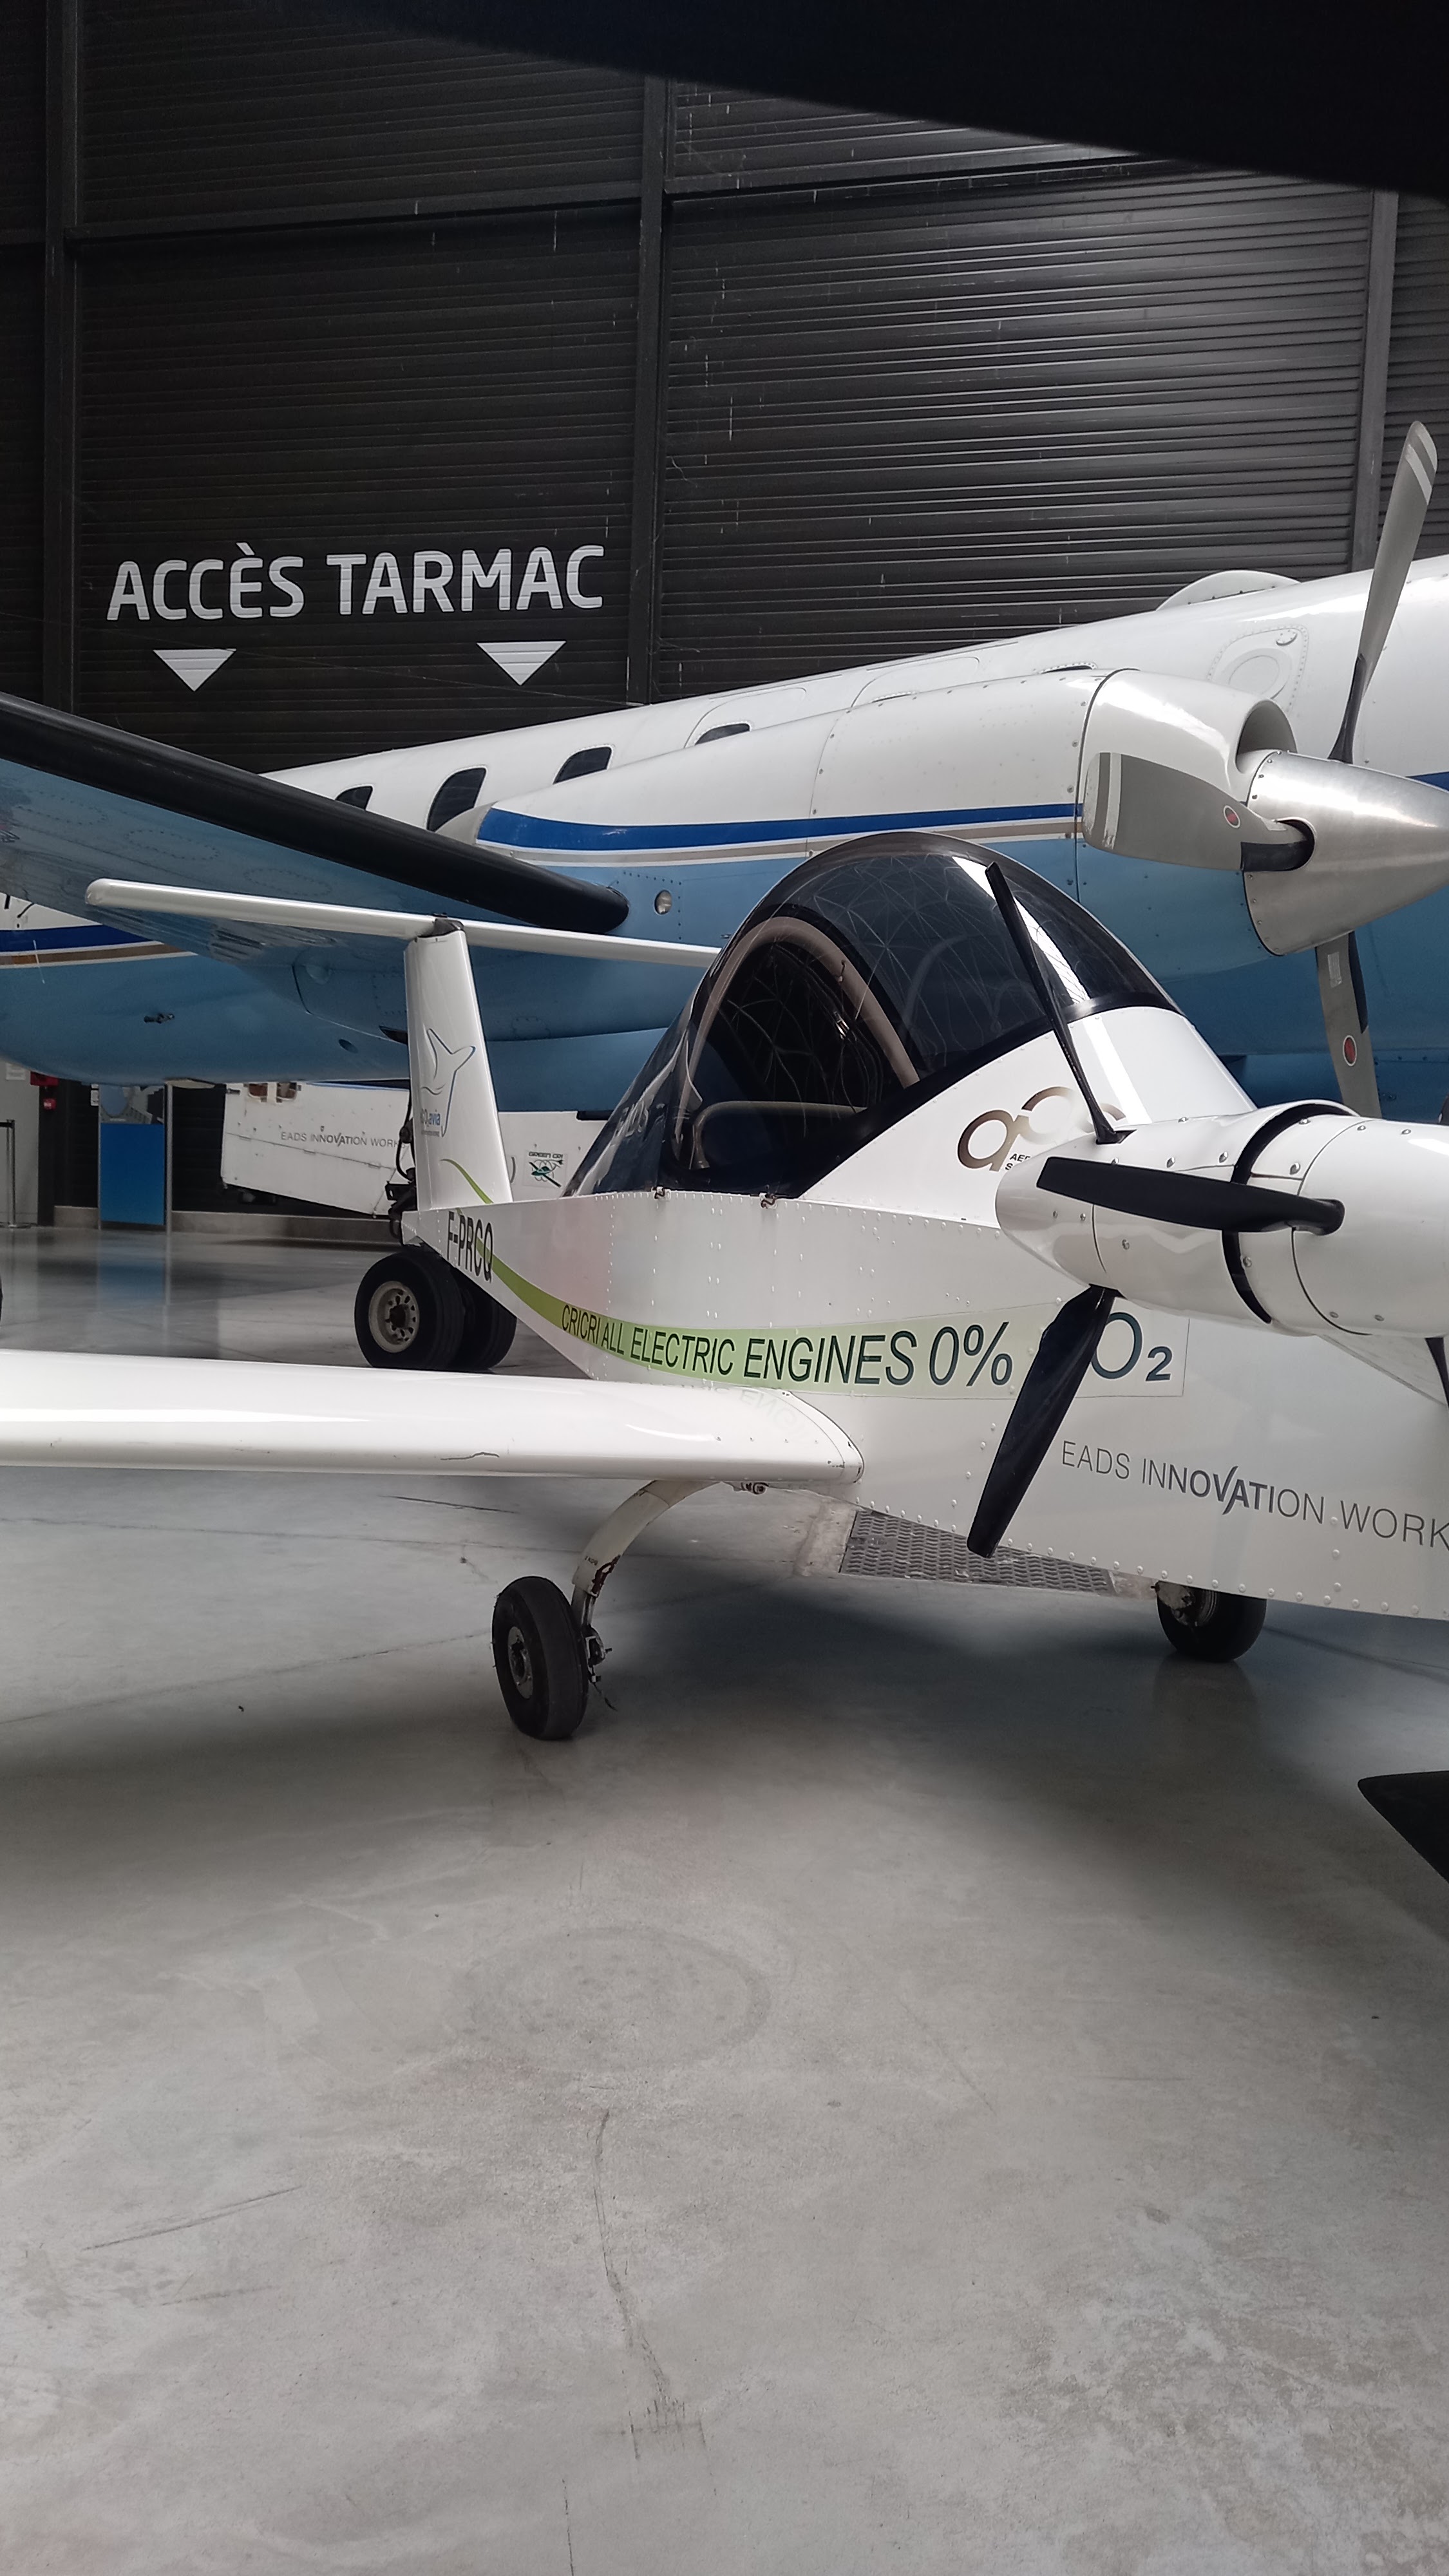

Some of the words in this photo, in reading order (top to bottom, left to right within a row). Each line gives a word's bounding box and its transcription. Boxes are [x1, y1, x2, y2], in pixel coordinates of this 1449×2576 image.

[106, 542, 304, 621] ACCÈS
[327, 545, 605, 616] TARMAC
[281, 1132, 307, 1142] EADS
[310, 1132, 367, 1147] INNOVATION
[447, 1211, 493, 1283] F-PRCQ
[562, 1305, 601, 1344] CRICRI
[601, 1323, 624, 1355] ALL
[630, 1327, 735, 1376] ELECTRIC
[743, 1331, 918, 1385] ENGINES
[929, 1321, 1013, 1387] 0%
[1091, 1312, 1173, 1382] O2
[1061, 1440, 1130, 1480] EADS
[1142, 1458, 1325, 1525] INNOVATION
